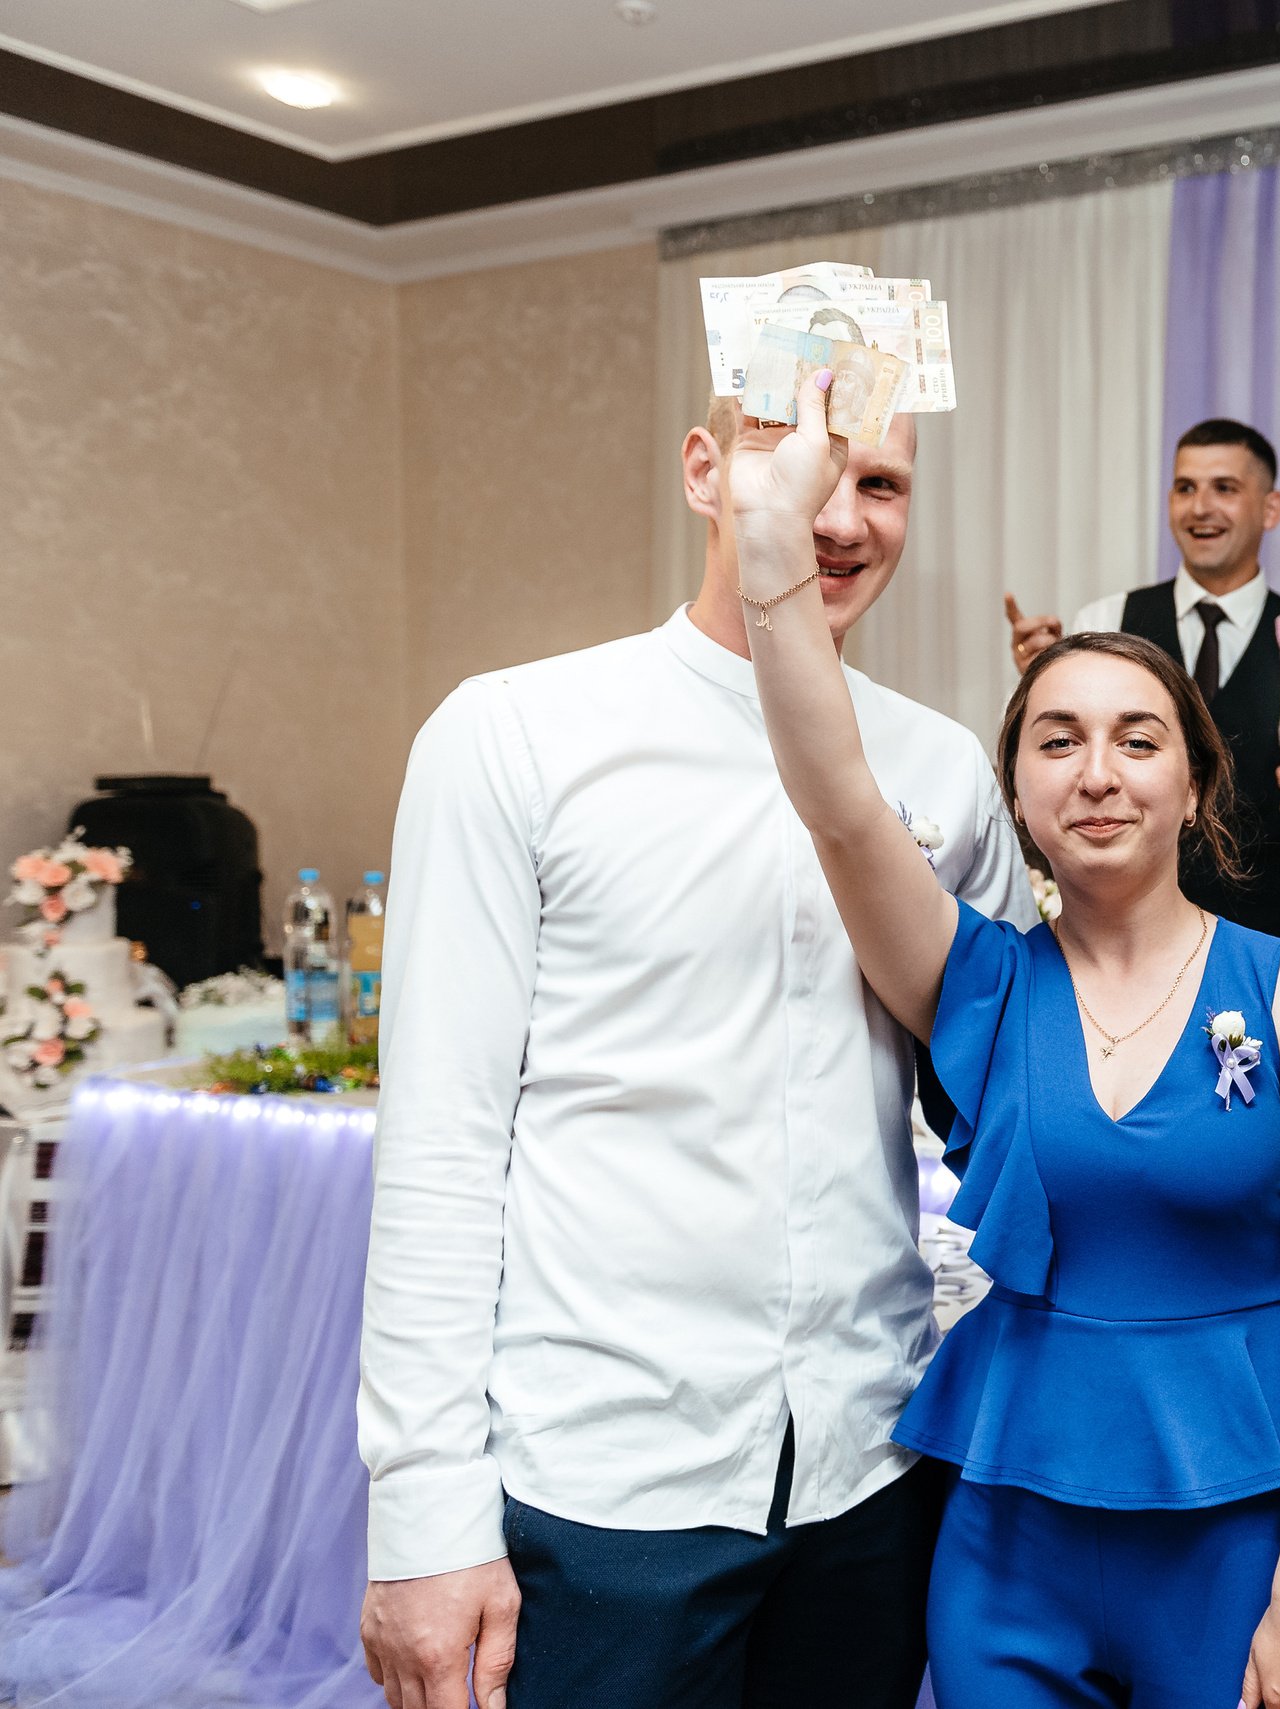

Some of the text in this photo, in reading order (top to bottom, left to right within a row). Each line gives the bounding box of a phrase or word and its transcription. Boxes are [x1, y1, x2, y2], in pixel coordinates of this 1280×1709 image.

[848, 283, 883, 291] УКРАЇНА
[866, 306, 900, 314] УКРАЇНА
[925, 315, 943, 345] 100
[939, 367, 949, 403] ГРИВЕНЬ
[763, 393, 771, 411] 1
